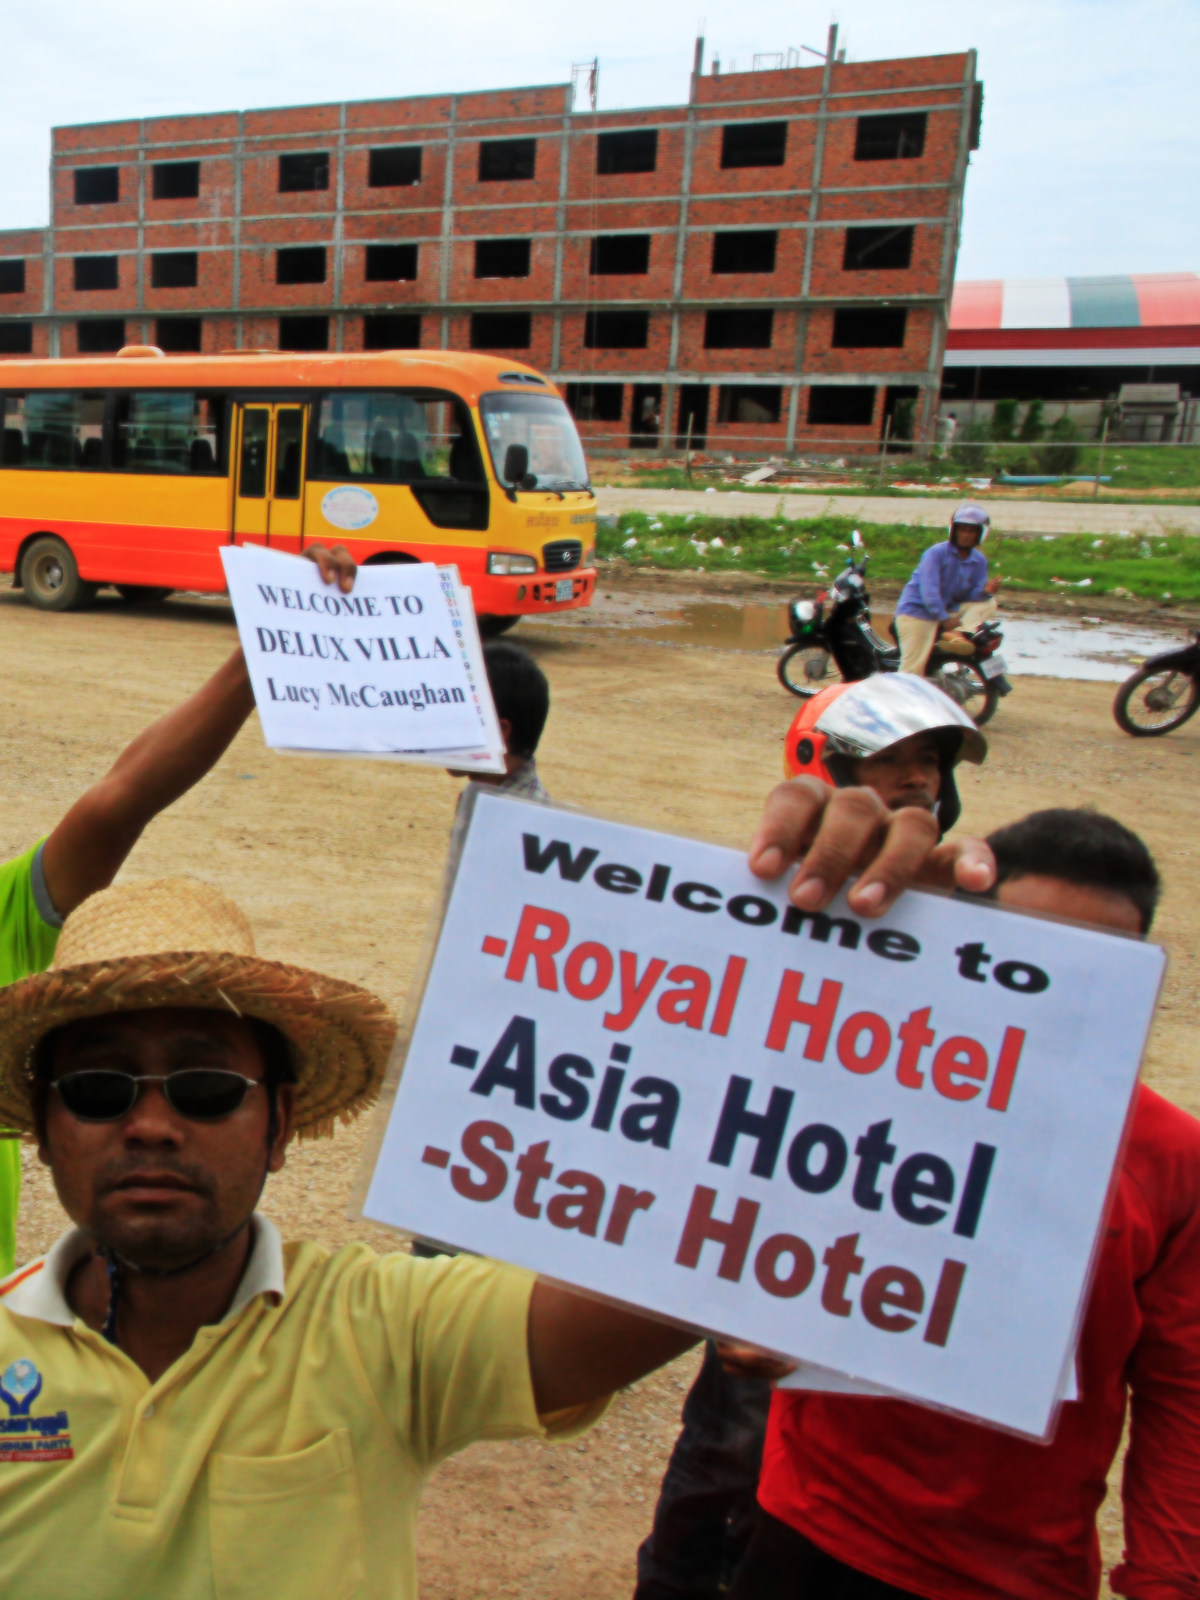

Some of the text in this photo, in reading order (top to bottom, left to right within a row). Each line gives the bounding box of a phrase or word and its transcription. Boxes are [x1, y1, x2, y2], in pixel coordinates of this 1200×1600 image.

[256, 627, 452, 662] DELUX VILLA
[257, 584, 424, 617] WELCOME TO
[267, 677, 466, 711] Lucy McCaughan
[521, 832, 1049, 994] Welcome to
[481, 903, 1026, 1113] -Royal Hotel
[449, 1015, 997, 1239] -Asia Hotel
[421, 1120, 966, 1348] -Star Hotel
